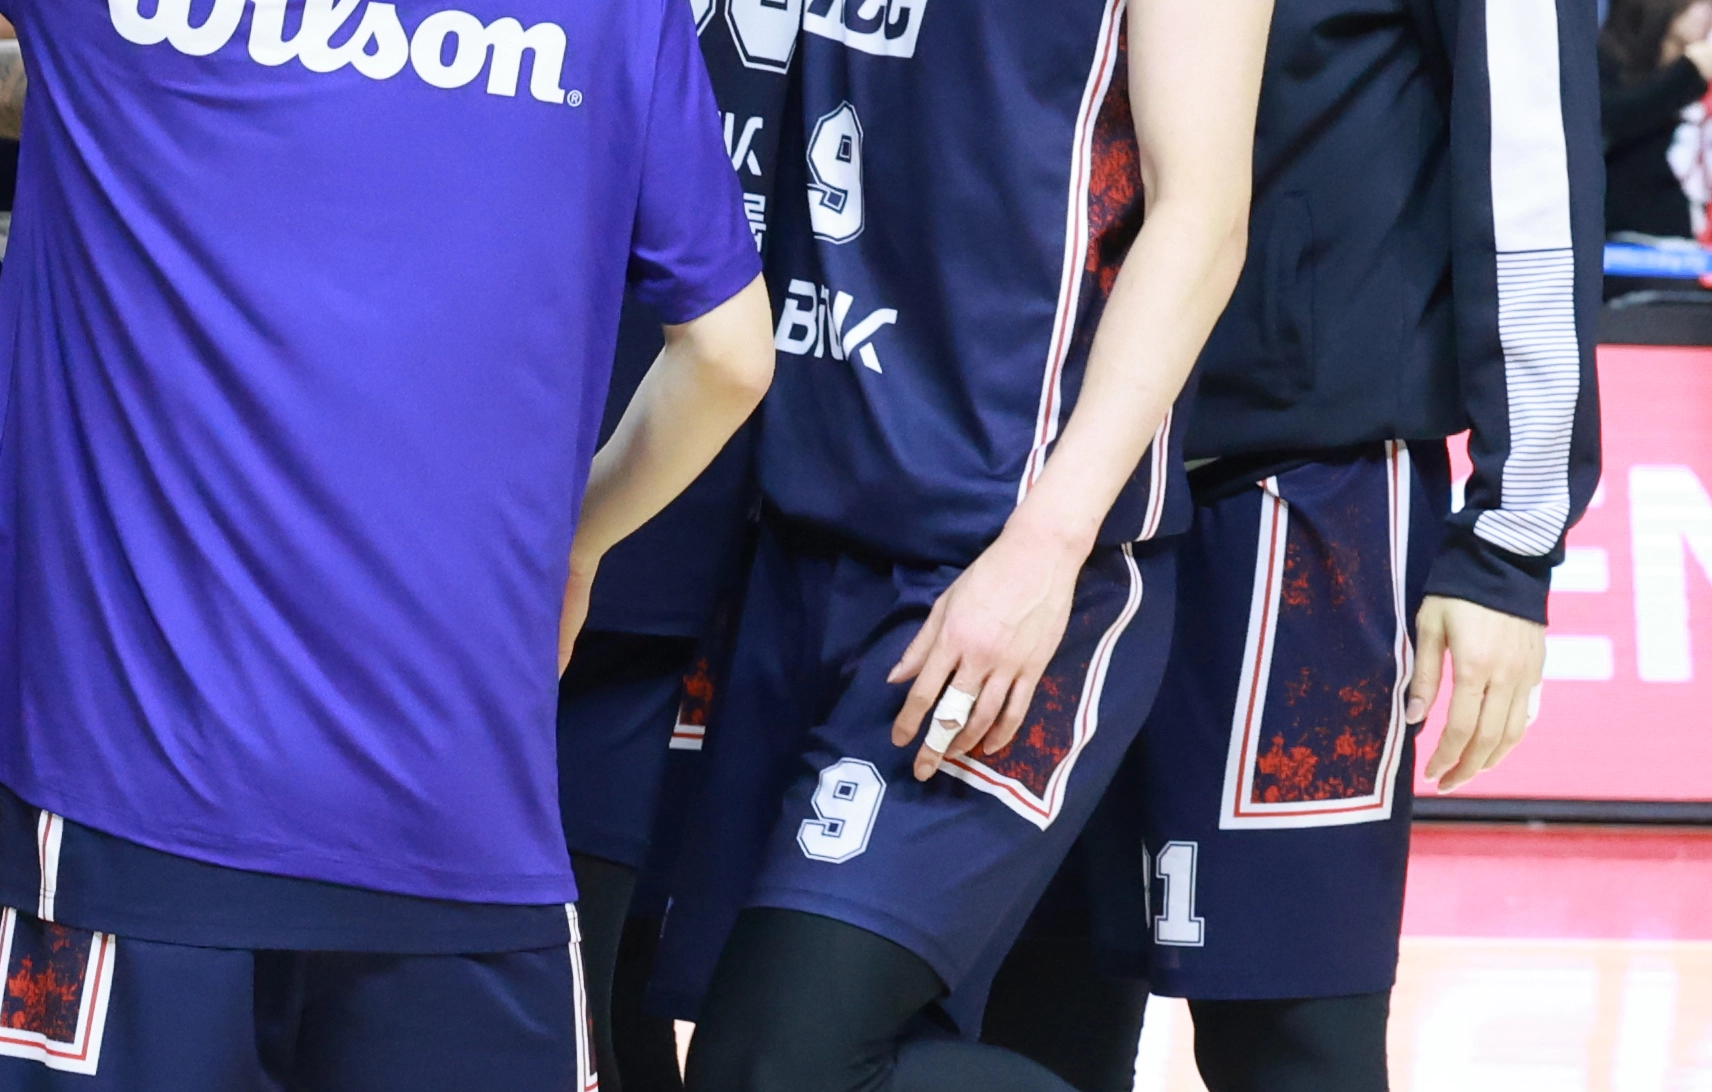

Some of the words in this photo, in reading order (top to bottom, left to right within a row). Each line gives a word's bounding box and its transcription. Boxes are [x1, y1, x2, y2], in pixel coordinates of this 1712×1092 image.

[806, 100, 866, 245] 9
[774, 278, 898, 375] BNK
[796, 756, 887, 864] 9
[1140, 839, 1205, 948] 1
